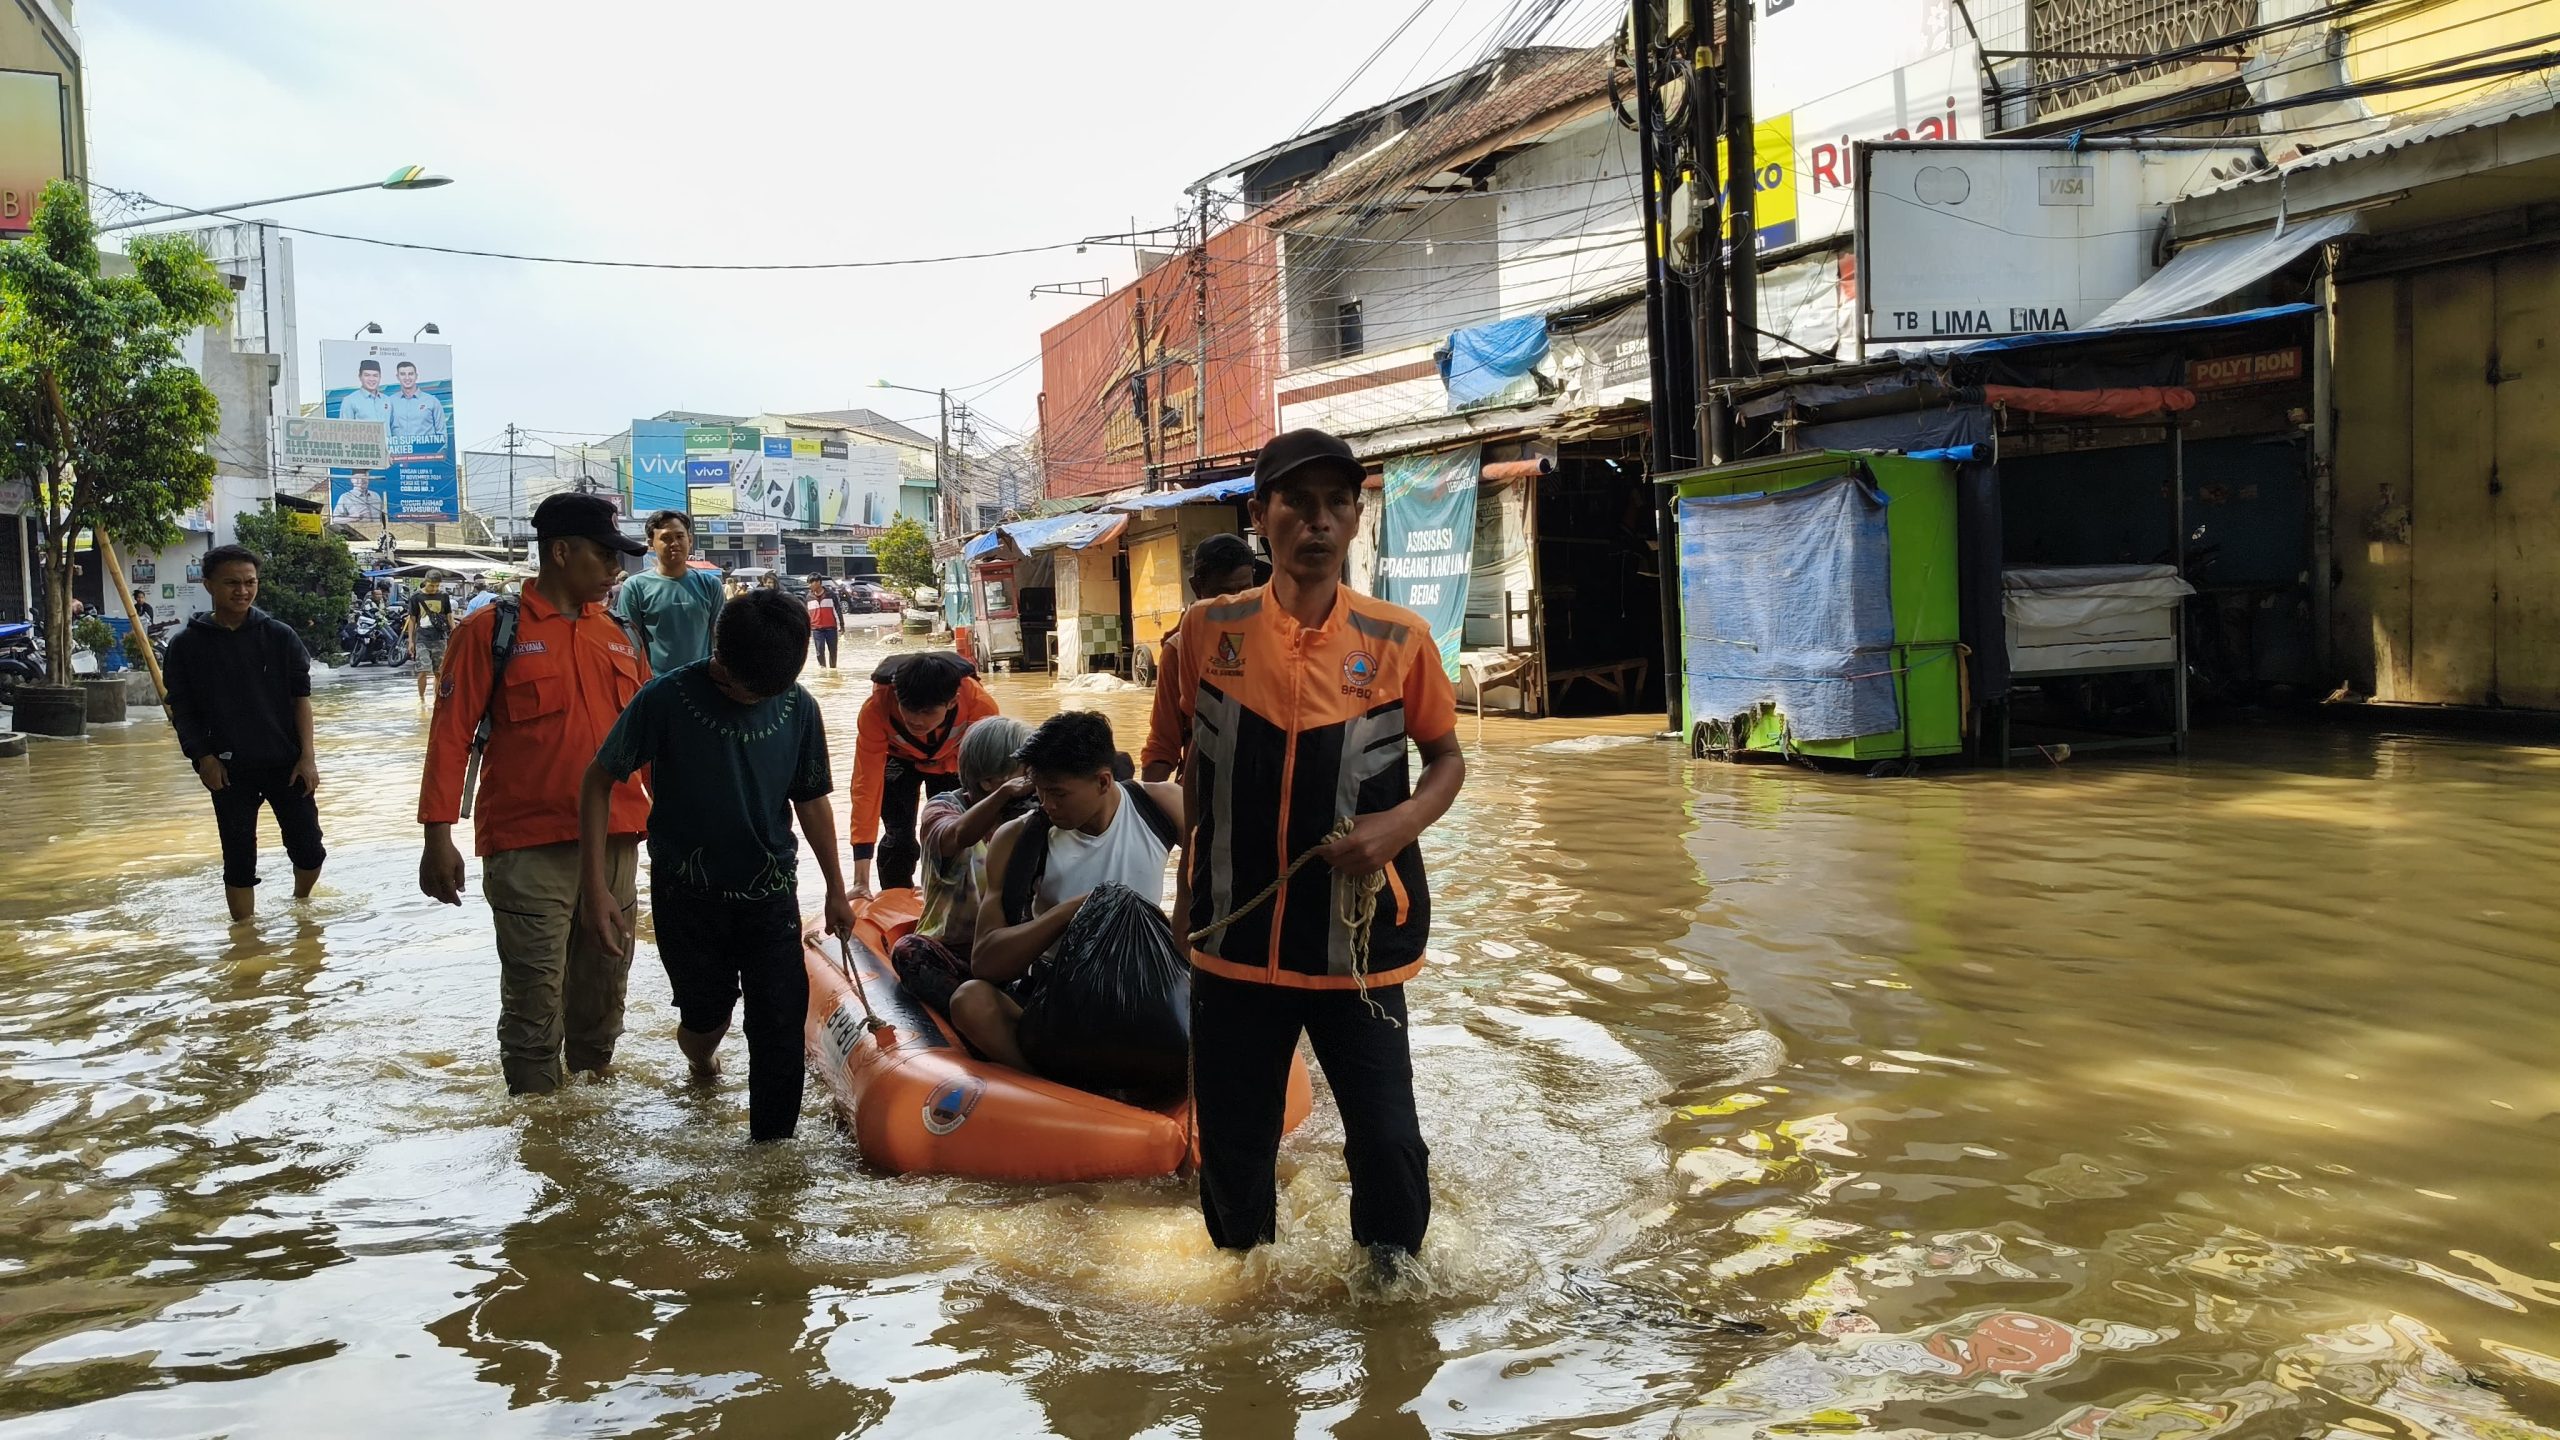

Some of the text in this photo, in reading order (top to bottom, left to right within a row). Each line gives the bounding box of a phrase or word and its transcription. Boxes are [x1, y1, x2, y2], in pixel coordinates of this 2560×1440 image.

[2050, 178, 2084, 194] VISA
[1893, 308, 2069, 335] TB LIMA LIMA
[1616, 337, 1649, 357] LEBIH
[2197, 352, 2294, 380] POLYTRON
[329, 423, 380, 434] HARAPAN
[341, 433, 380, 443] MAHAL
[400, 434, 445, 445] SUPRIATNA
[823, 446, 847, 454] SAMSUNG
[695, 467, 723, 476] vivo
[1409, 584, 1440, 605] BEDAS
[1341, 685, 1373, 700] BPBD
